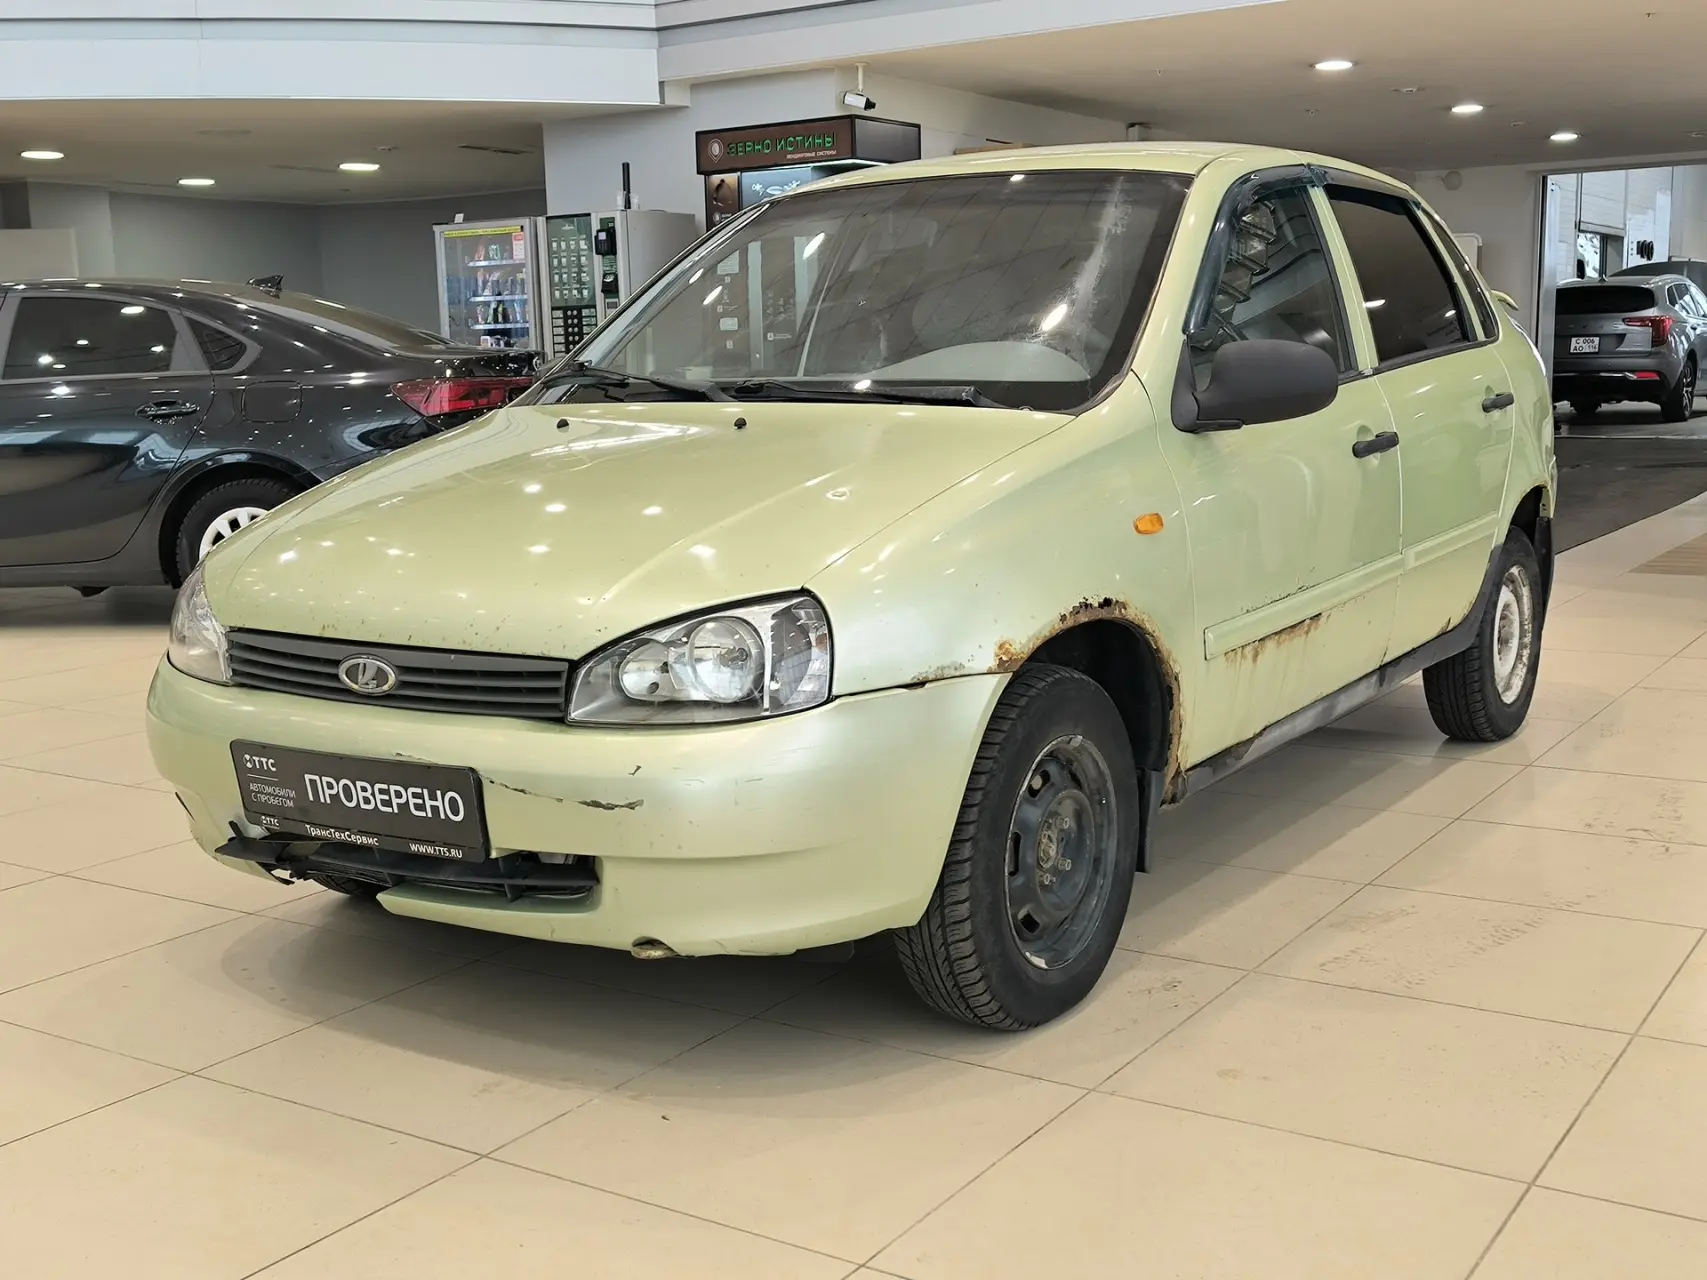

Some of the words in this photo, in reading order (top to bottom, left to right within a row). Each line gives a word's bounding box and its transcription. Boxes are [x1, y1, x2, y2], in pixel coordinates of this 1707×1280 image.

[728, 140, 772, 156] ЗЕРНО
[776, 133, 836, 151] ИСТИНЫ
[252, 756, 277, 772] ТТС
[249, 782, 297, 798] АВТОМОБИЛИ
[304, 773, 465, 822] ПРОВЕРЕНО
[251, 793, 258, 802] С
[257, 794, 294, 808] ПРОБЕГОМ
[266, 817, 280, 826] ТТС
[305, 824, 379, 846] ТрансТехСервис
[409, 843, 463, 859] WWW.TTS.RU
